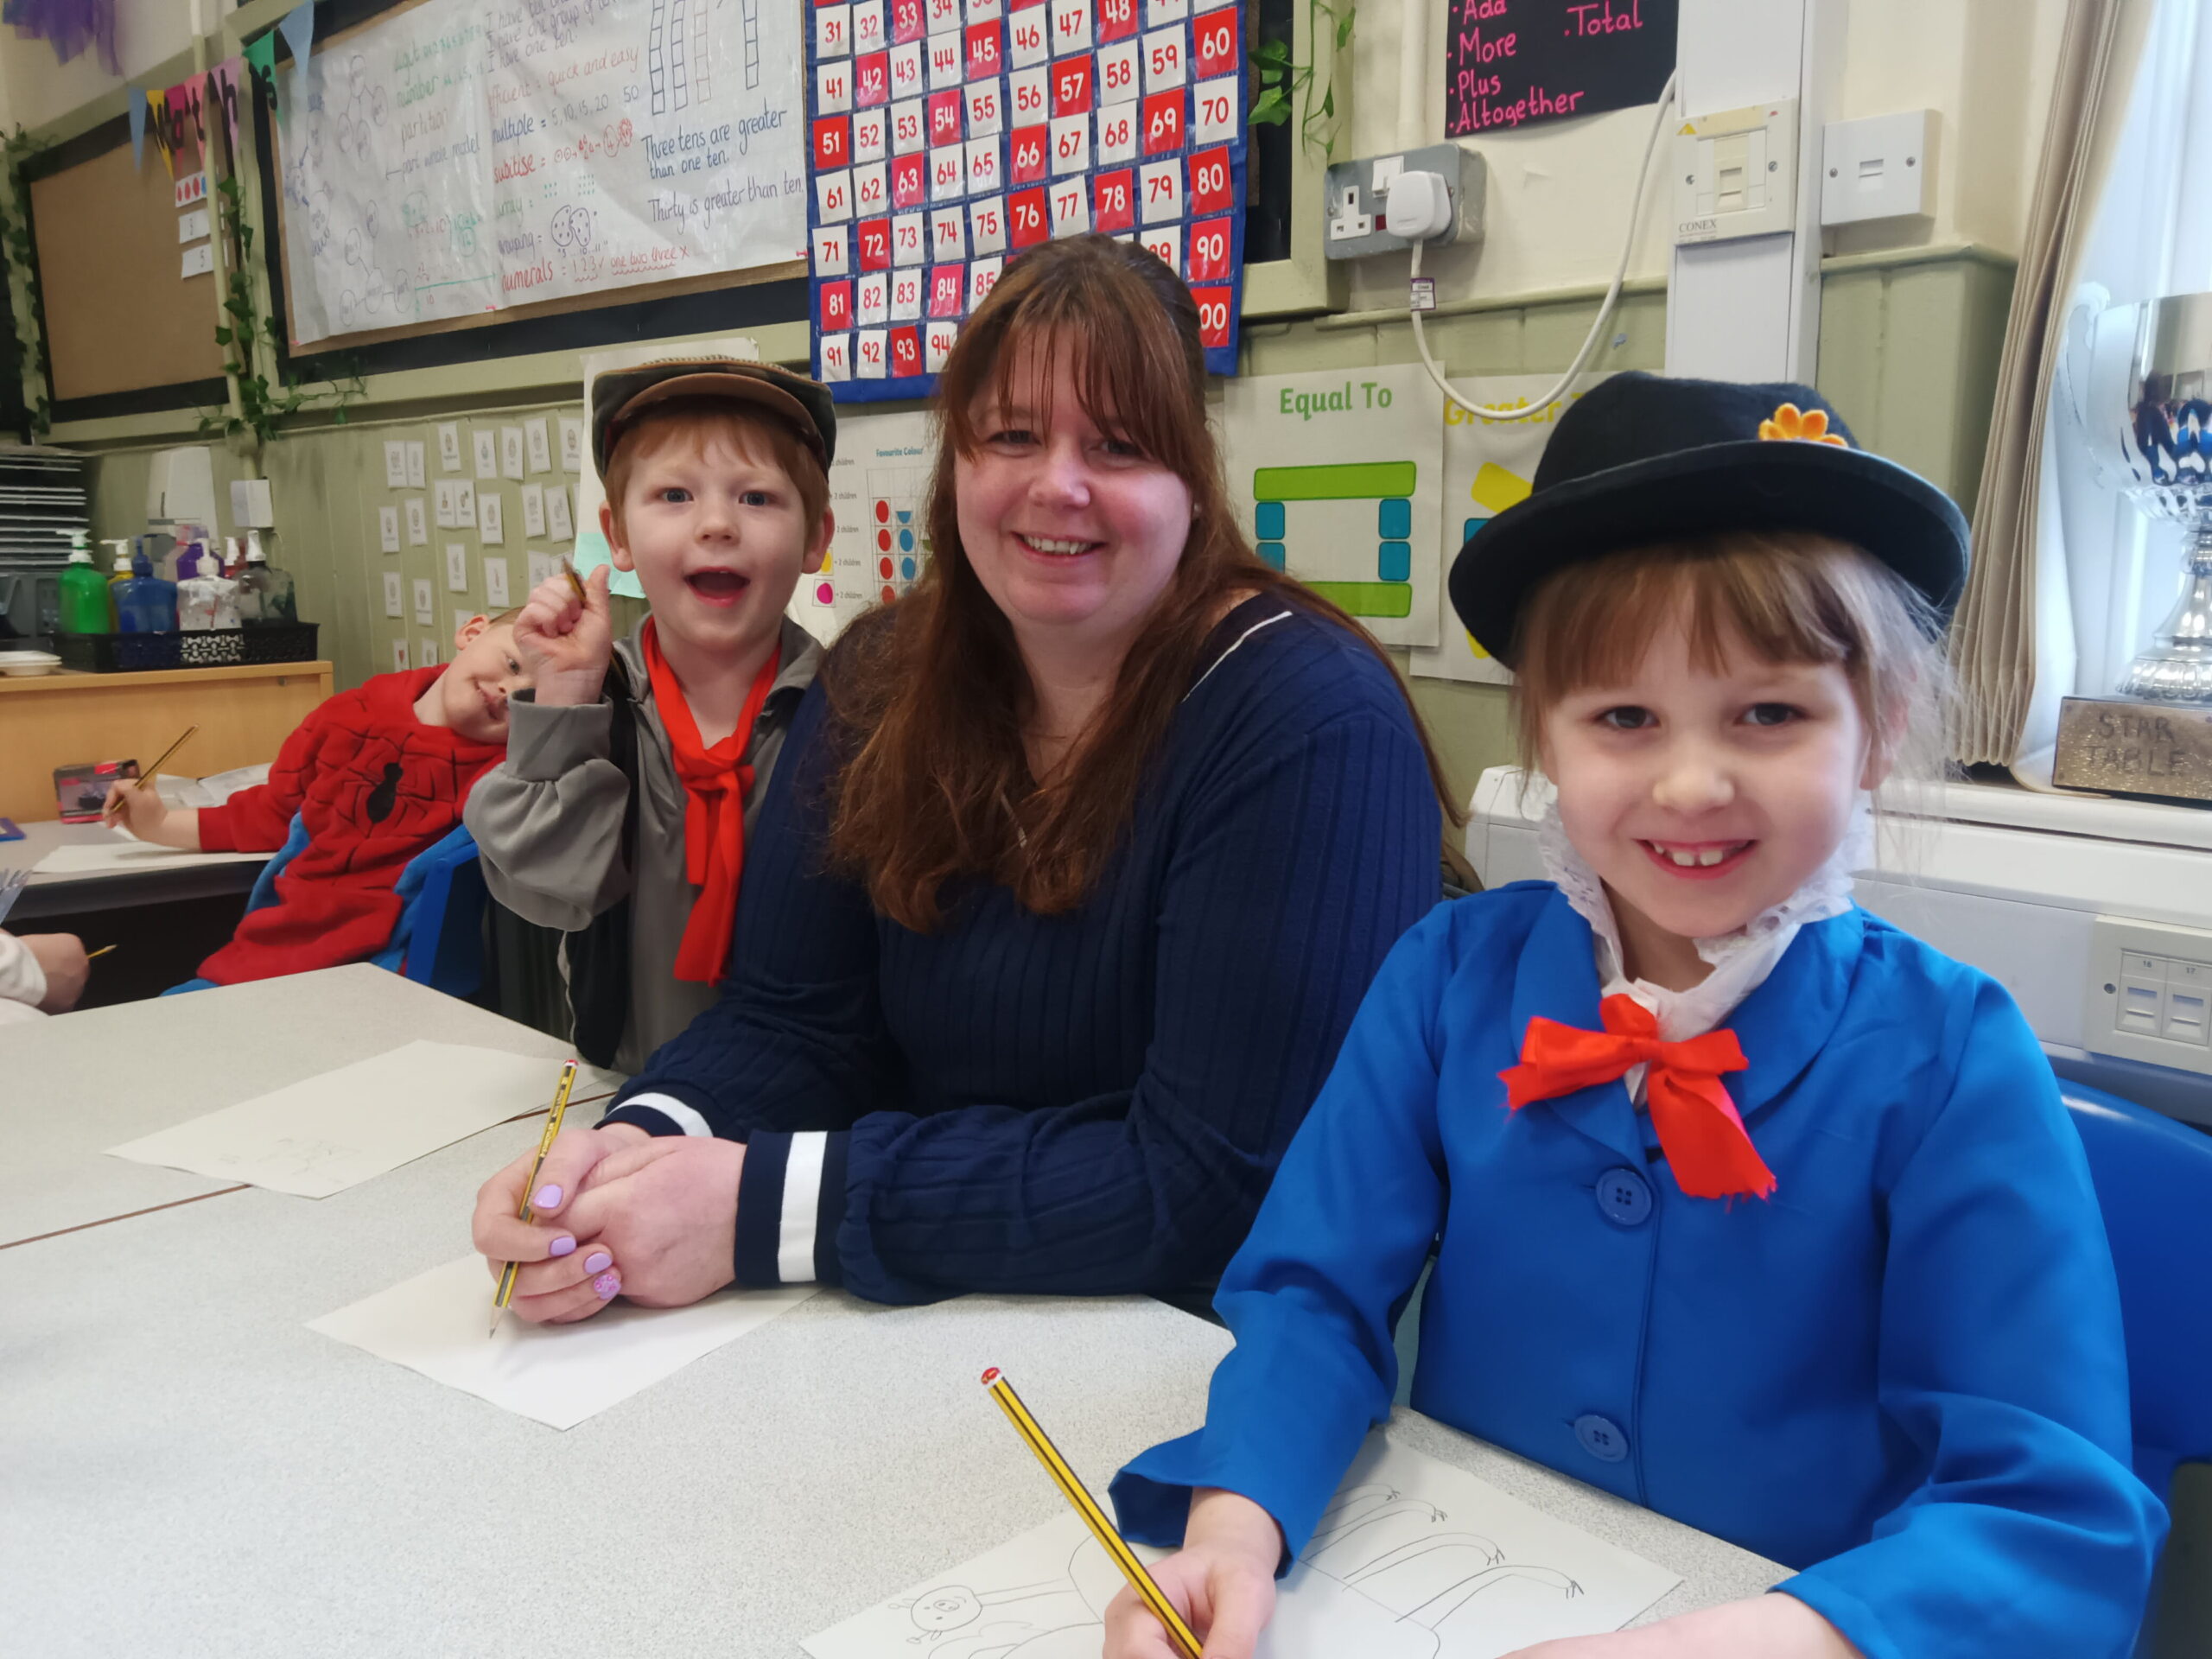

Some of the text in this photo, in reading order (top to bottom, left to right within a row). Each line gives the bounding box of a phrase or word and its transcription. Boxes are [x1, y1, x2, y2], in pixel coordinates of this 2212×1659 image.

[825, 21, 842, 43] 31
[861, 15, 878, 40] 32
[899, 3, 918, 29] 33
[1567, 0, 1643, 36] Total
[583, 52, 607, 76] and
[611, 46, 639, 73] easy
[826, 0, 1130, 99] 41 42 43 44 45 46 47 48
[1459, 27, 1516, 66] More
[823, 27, 1230, 155] 51 52 53 54 55 56 57 58 59 60
[1458, 69, 1501, 102] Plus
[640, 97, 787, 162] Three tens are greater
[1456, 86, 1585, 133] Altogether
[650, 148, 730, 180] than one ten.
[827, 96, 1229, 209] 61 62 63 64 65 66 67 68 69 70
[648, 170, 804, 235] Thirty is greater than ten.
[823, 163, 1224, 263] 71 72 73 74 75 76 77 78 79 80
[1679, 219, 1717, 233] CONEX
[501, 256, 554, 294] numerals
[830, 293, 844, 316] 81
[863, 286, 881, 309] 82
[897, 282, 915, 304] 83
[937, 277, 957, 302] 84
[976, 271, 995, 296] 85
[1197, 233, 1224, 261] 90
[827, 346, 842, 367] 91
[862, 341, 880, 363] 92
[897, 338, 916, 361] 93
[931, 334, 951, 356] 94
[1280, 381, 1392, 421] Equal To
[875, 447, 924, 458] Favourite Colour
